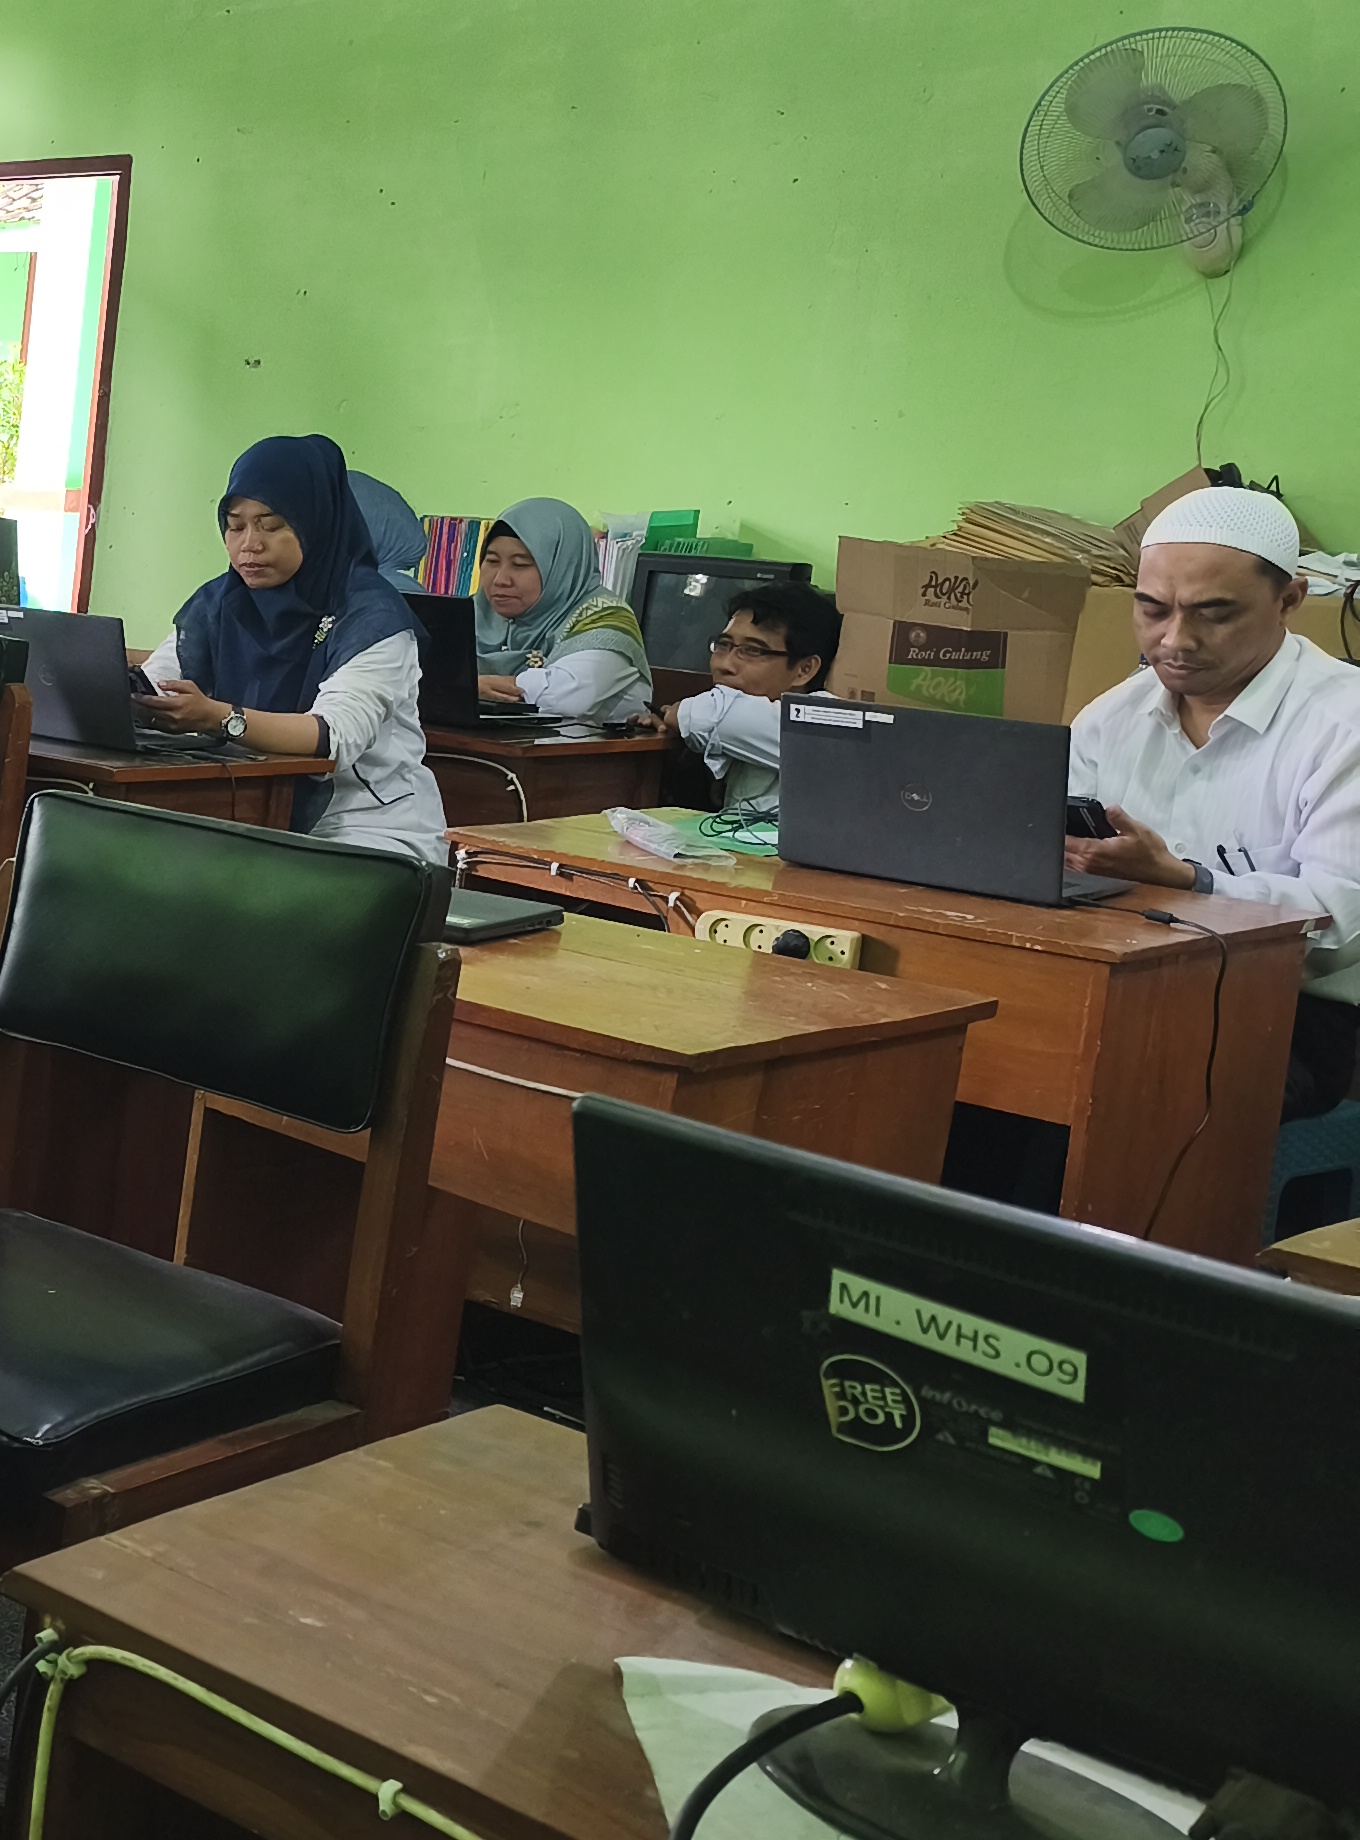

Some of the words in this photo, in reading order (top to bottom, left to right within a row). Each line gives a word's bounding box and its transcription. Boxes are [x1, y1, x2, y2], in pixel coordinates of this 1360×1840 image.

[906, 647, 936, 660] Roti
[939, 646, 992, 662] Gulung
[915, 1307, 1002, 1361] WHS
[826, 1378, 905, 1409] FREE
